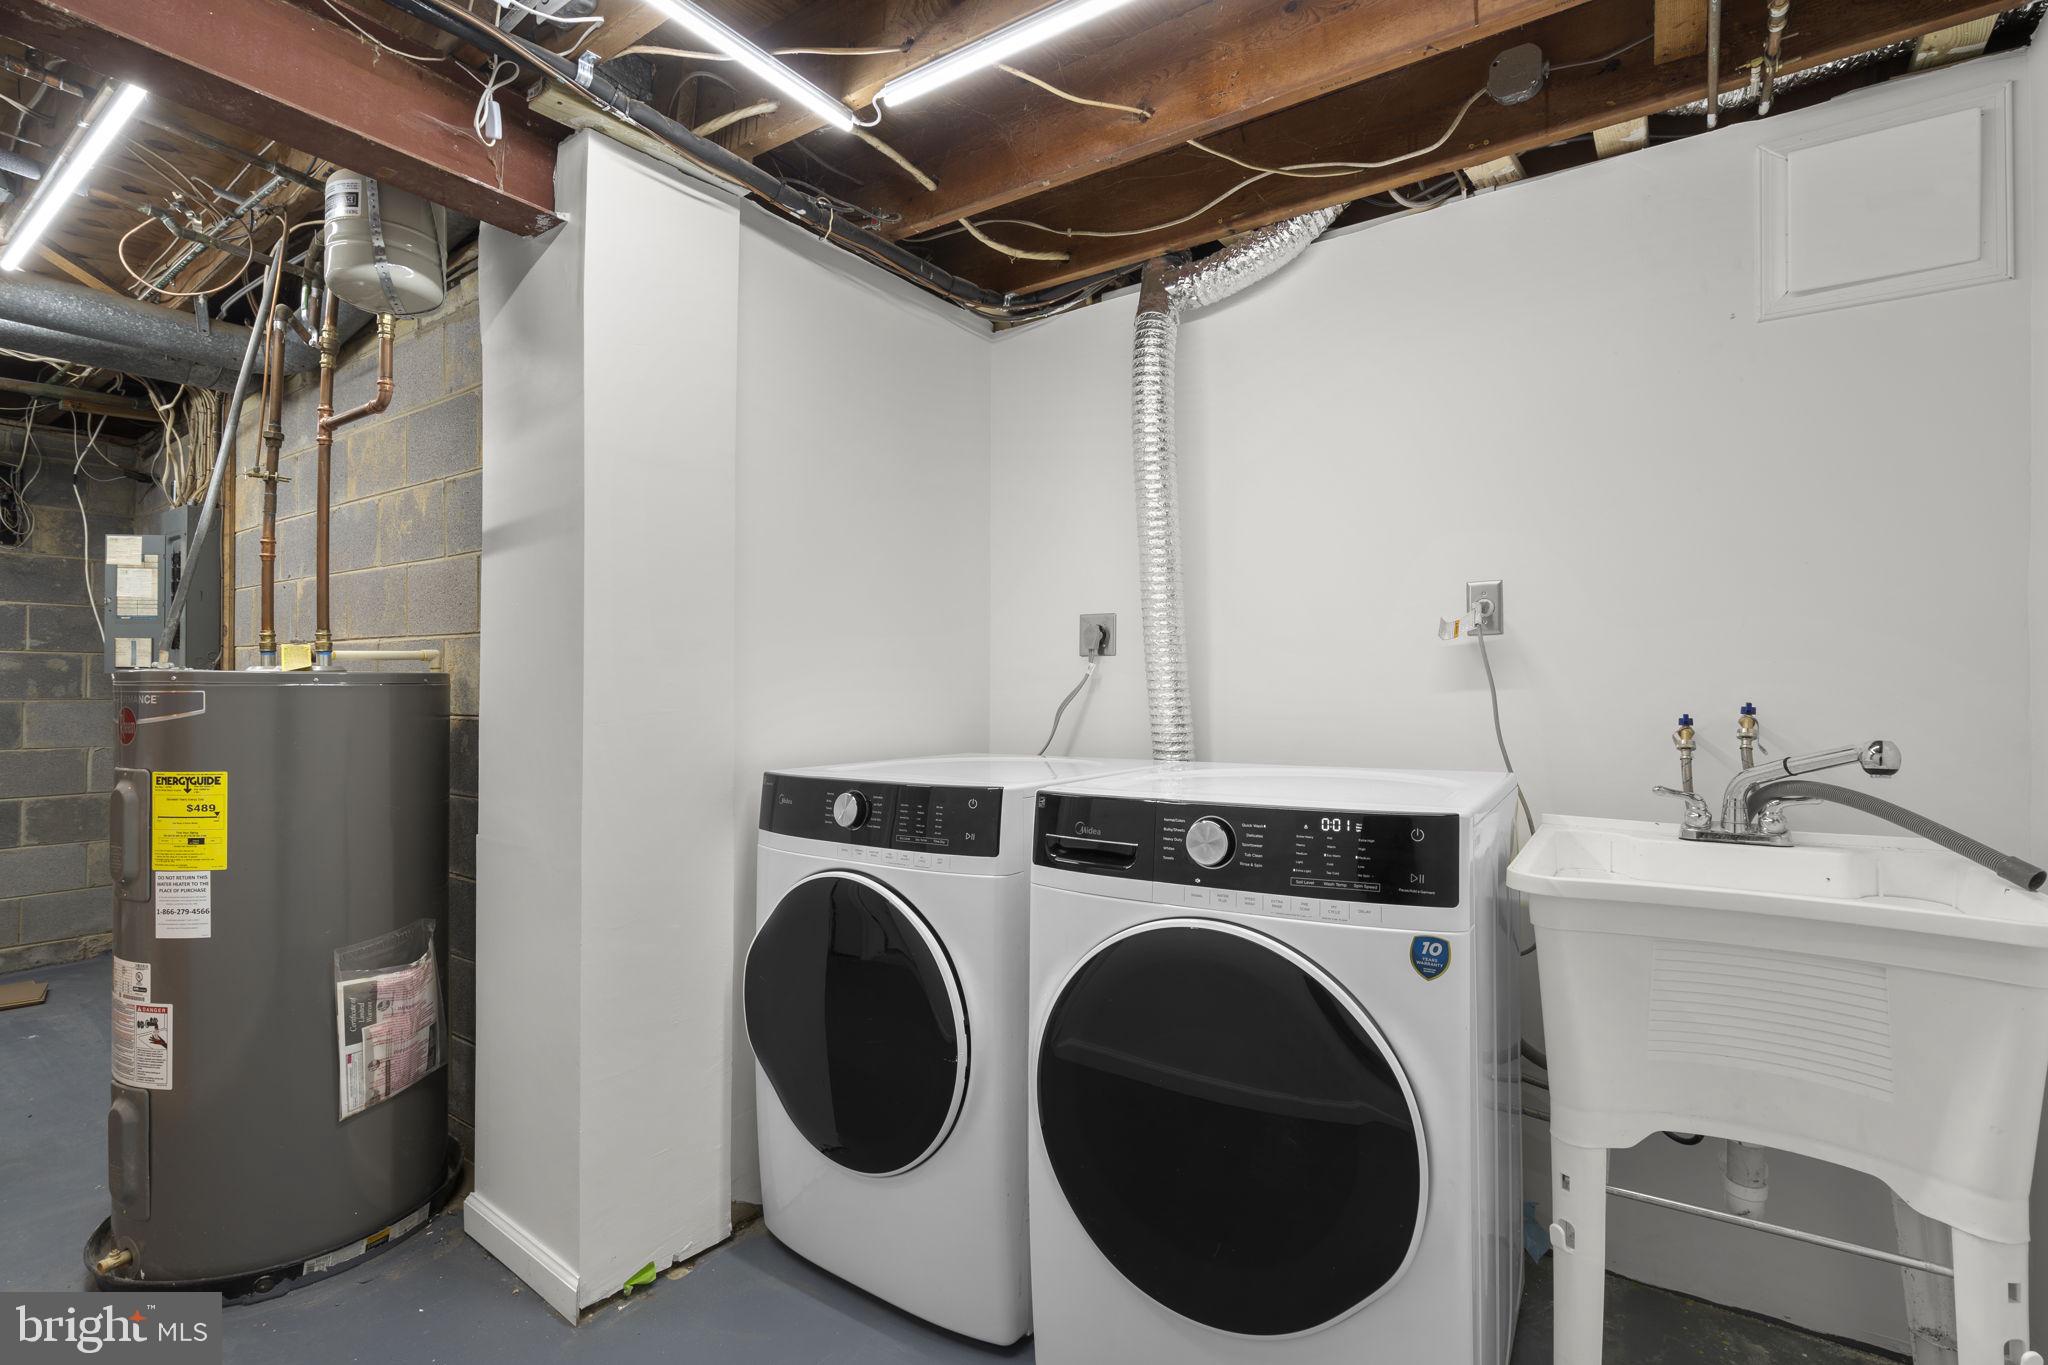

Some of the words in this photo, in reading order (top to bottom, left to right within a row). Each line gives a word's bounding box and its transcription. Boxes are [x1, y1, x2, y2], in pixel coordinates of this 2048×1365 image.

[156, 776, 222, 786] ENERGYGUIDE
[186, 804, 216, 812] $489
[1075, 821, 1102, 835] Midea
[1421, 941, 1443, 956] 10
